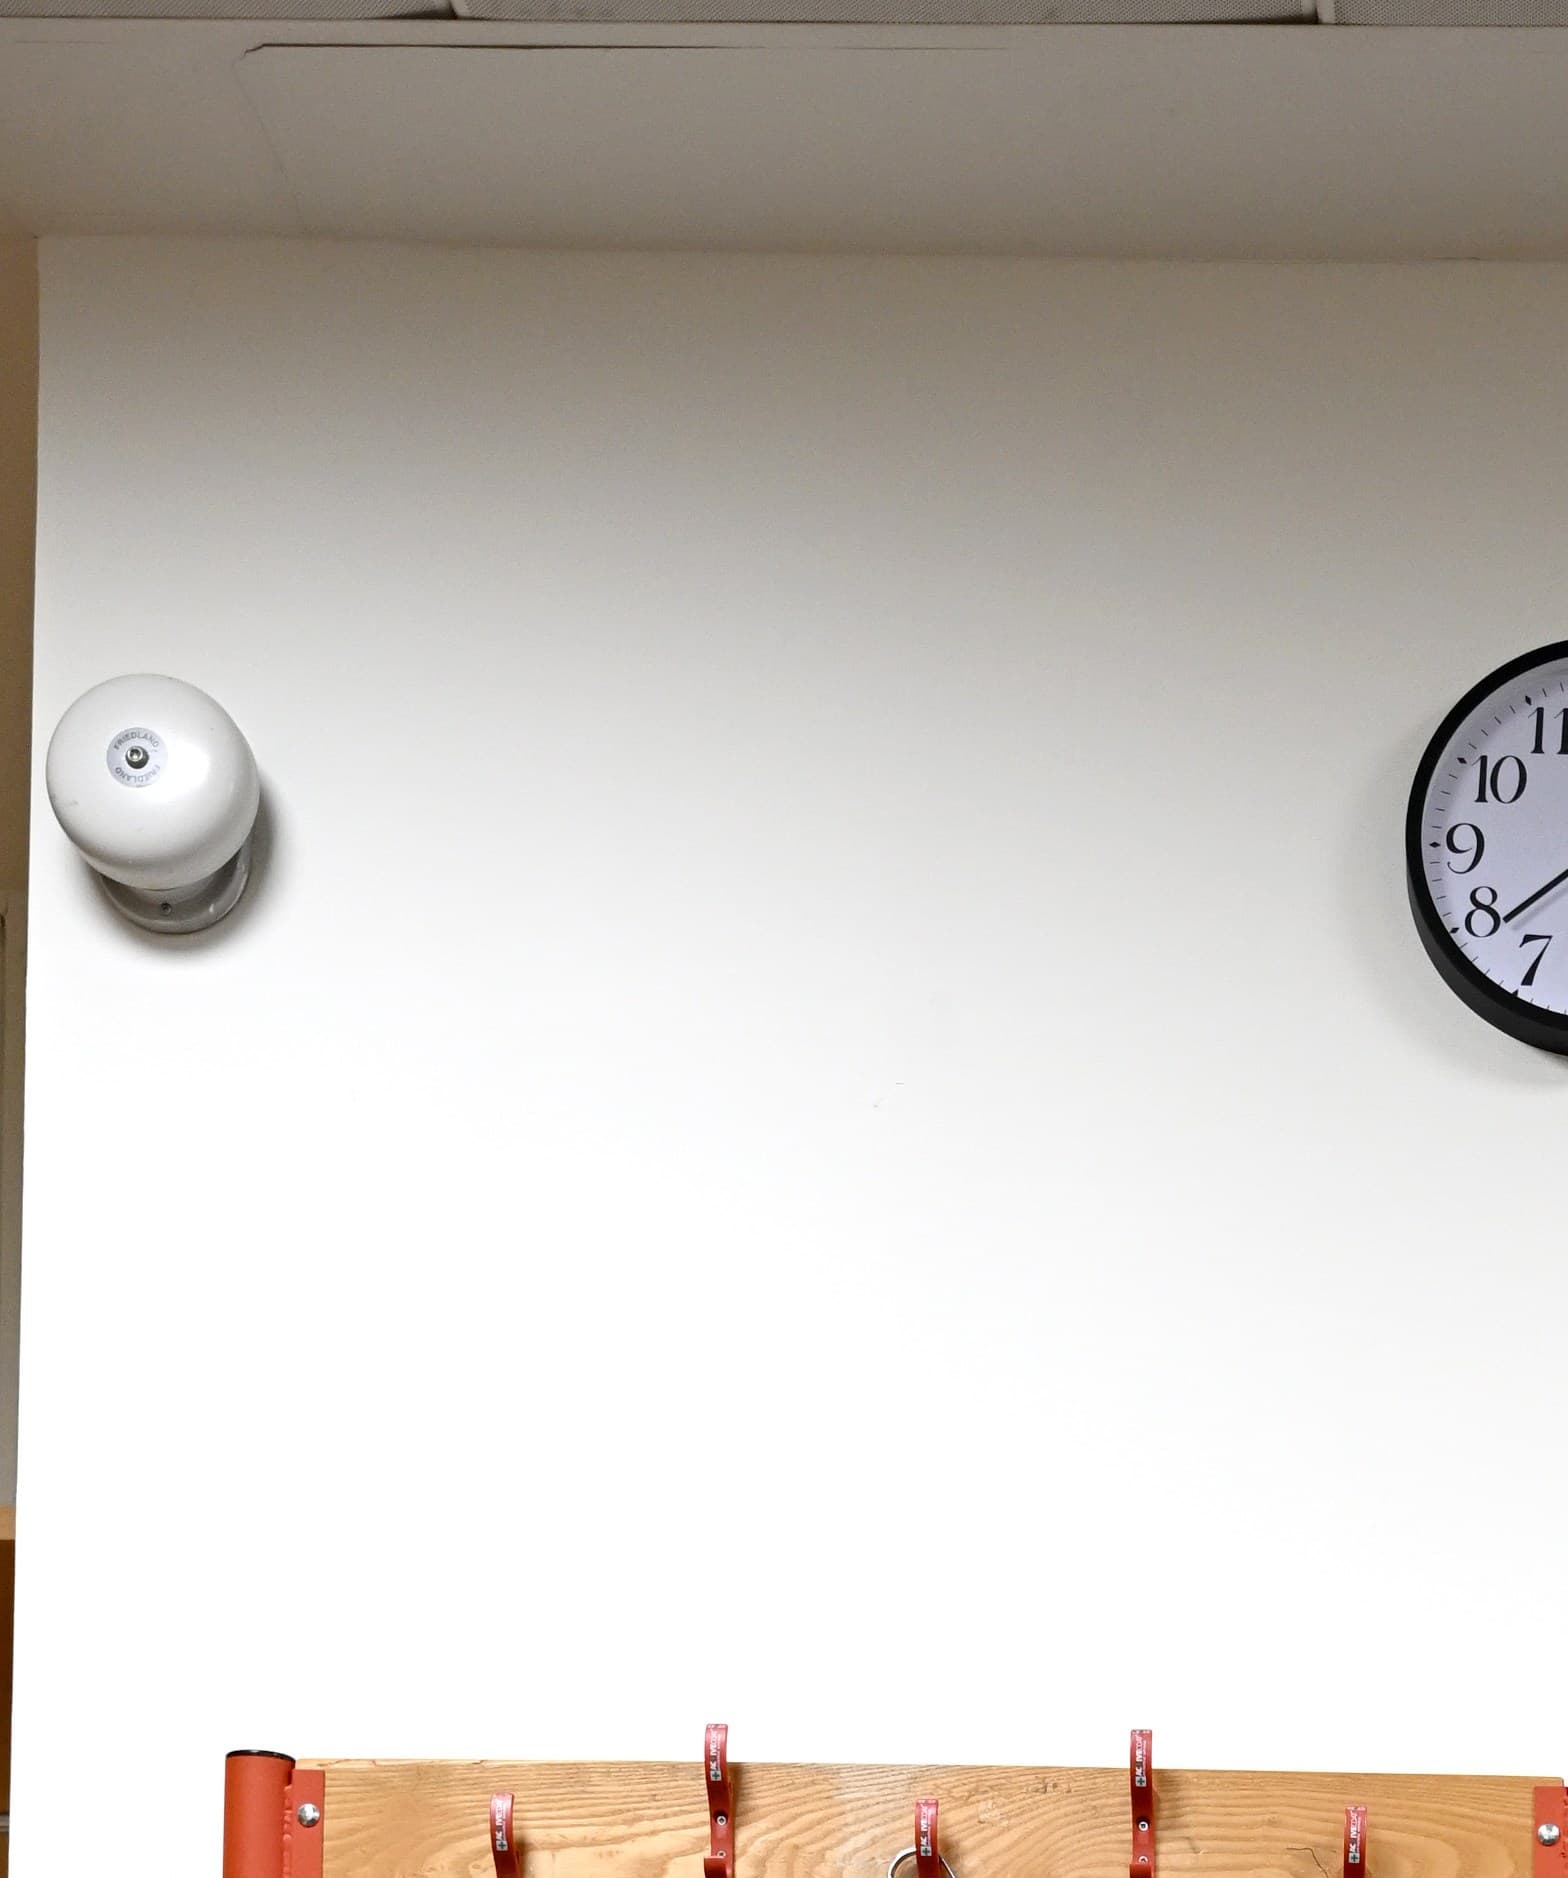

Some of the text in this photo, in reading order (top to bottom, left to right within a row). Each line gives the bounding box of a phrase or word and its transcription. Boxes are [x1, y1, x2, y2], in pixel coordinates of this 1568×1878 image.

[114, 732, 158, 749] FRIEDLAND
[1472, 755, 1527, 804] 10
[1446, 823, 1485, 874] 9
[1464, 886, 1501, 937] 8
[1519, 934, 1553, 986] 7
